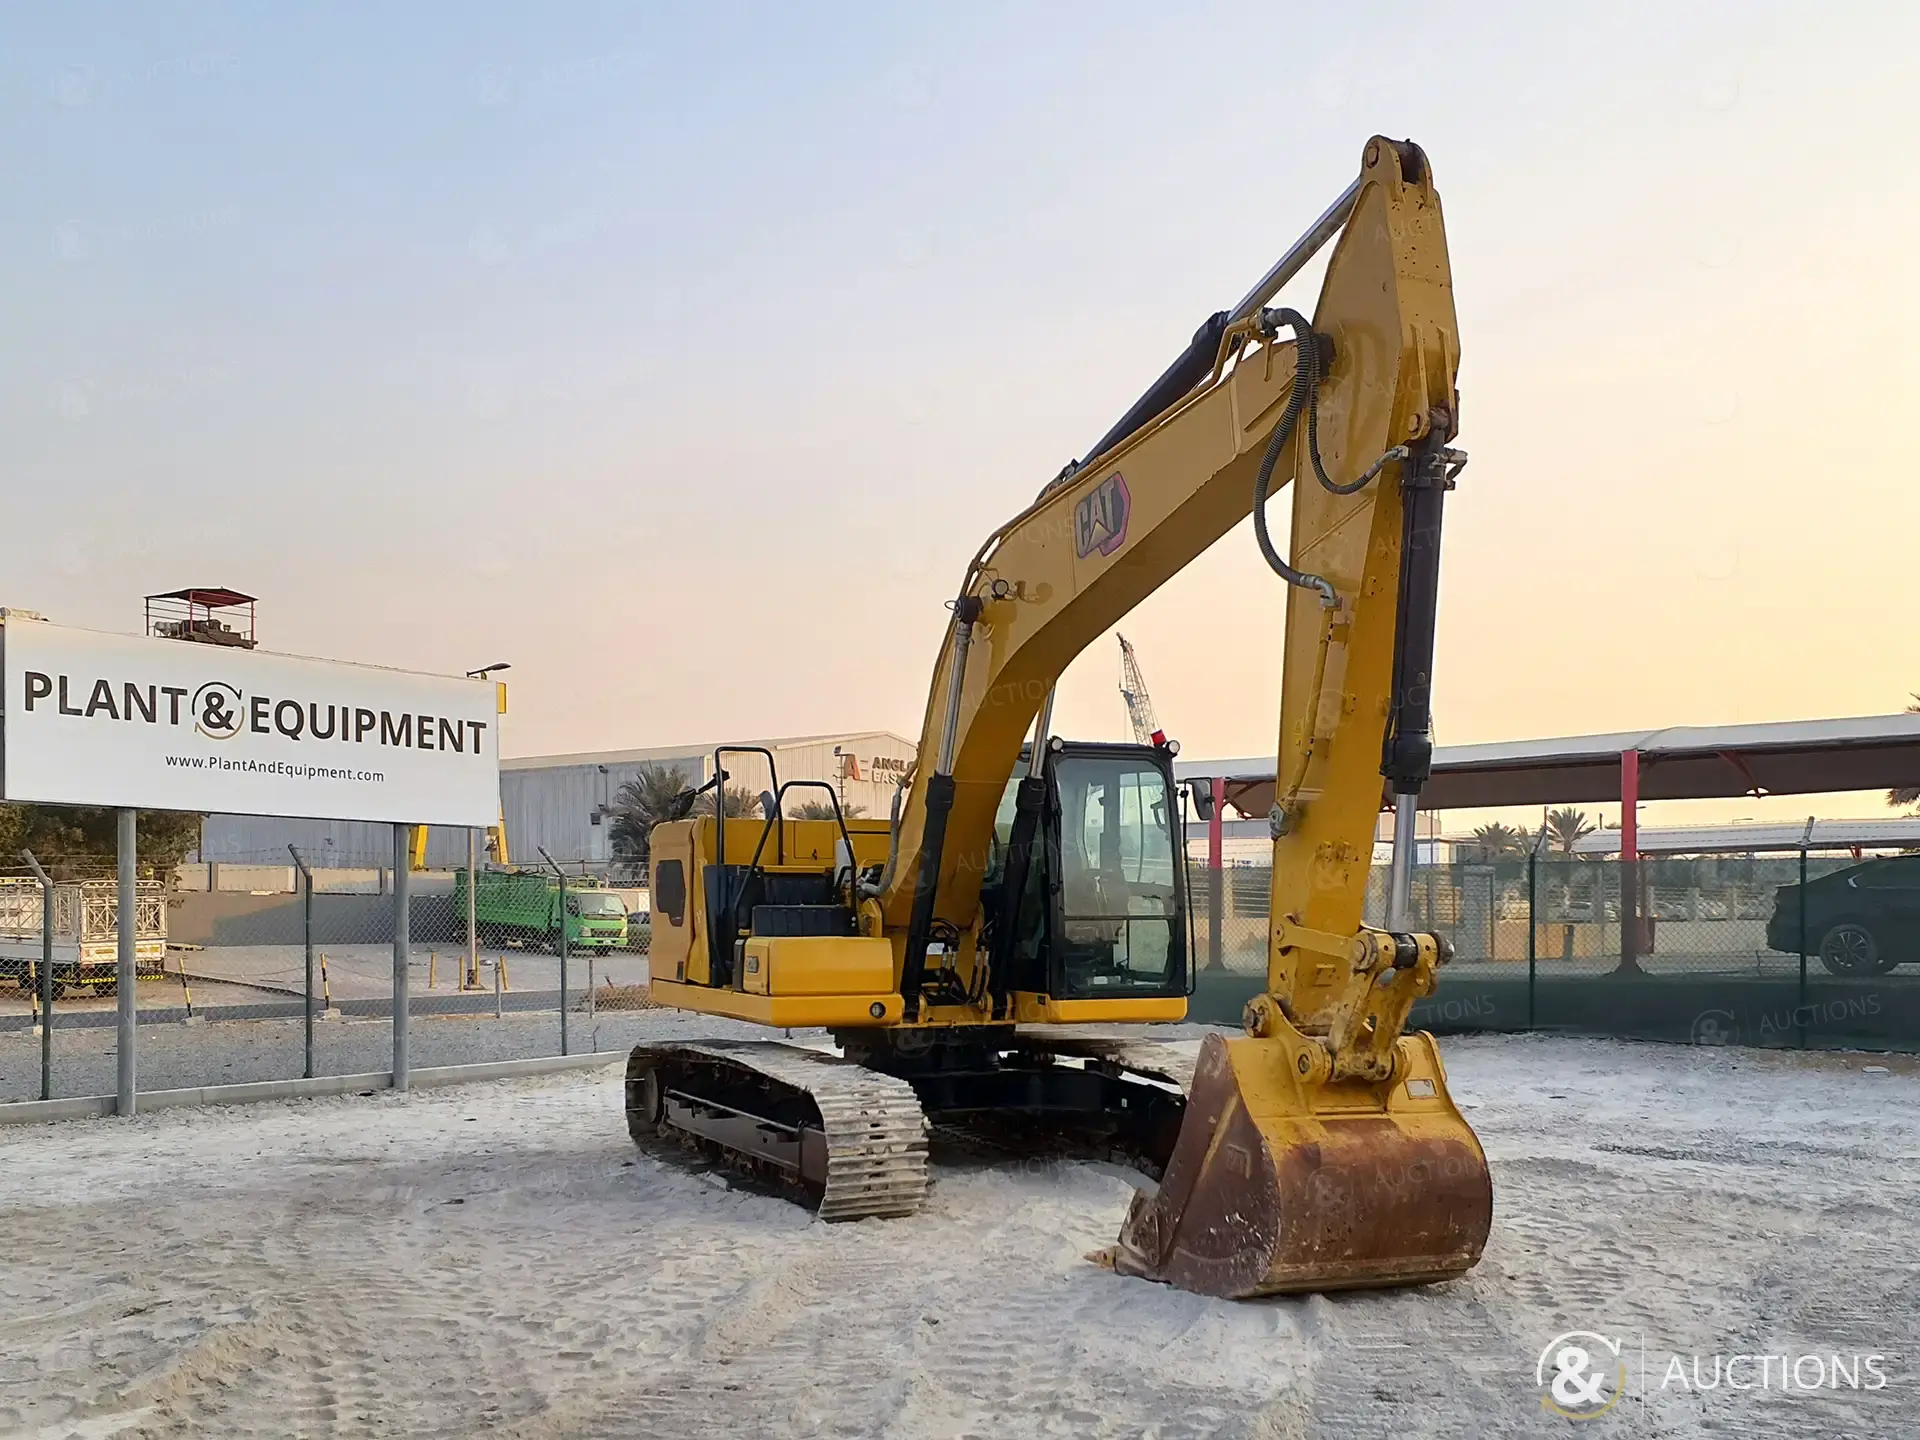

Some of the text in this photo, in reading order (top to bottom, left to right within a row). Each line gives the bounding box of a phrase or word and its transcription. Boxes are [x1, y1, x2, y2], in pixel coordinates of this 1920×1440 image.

[1075, 476, 1116, 558] CAT
[24, 671, 487, 755] PLANT & EQUIPMENT
[165, 755, 384, 783] www.PlantAndEquipment.com
